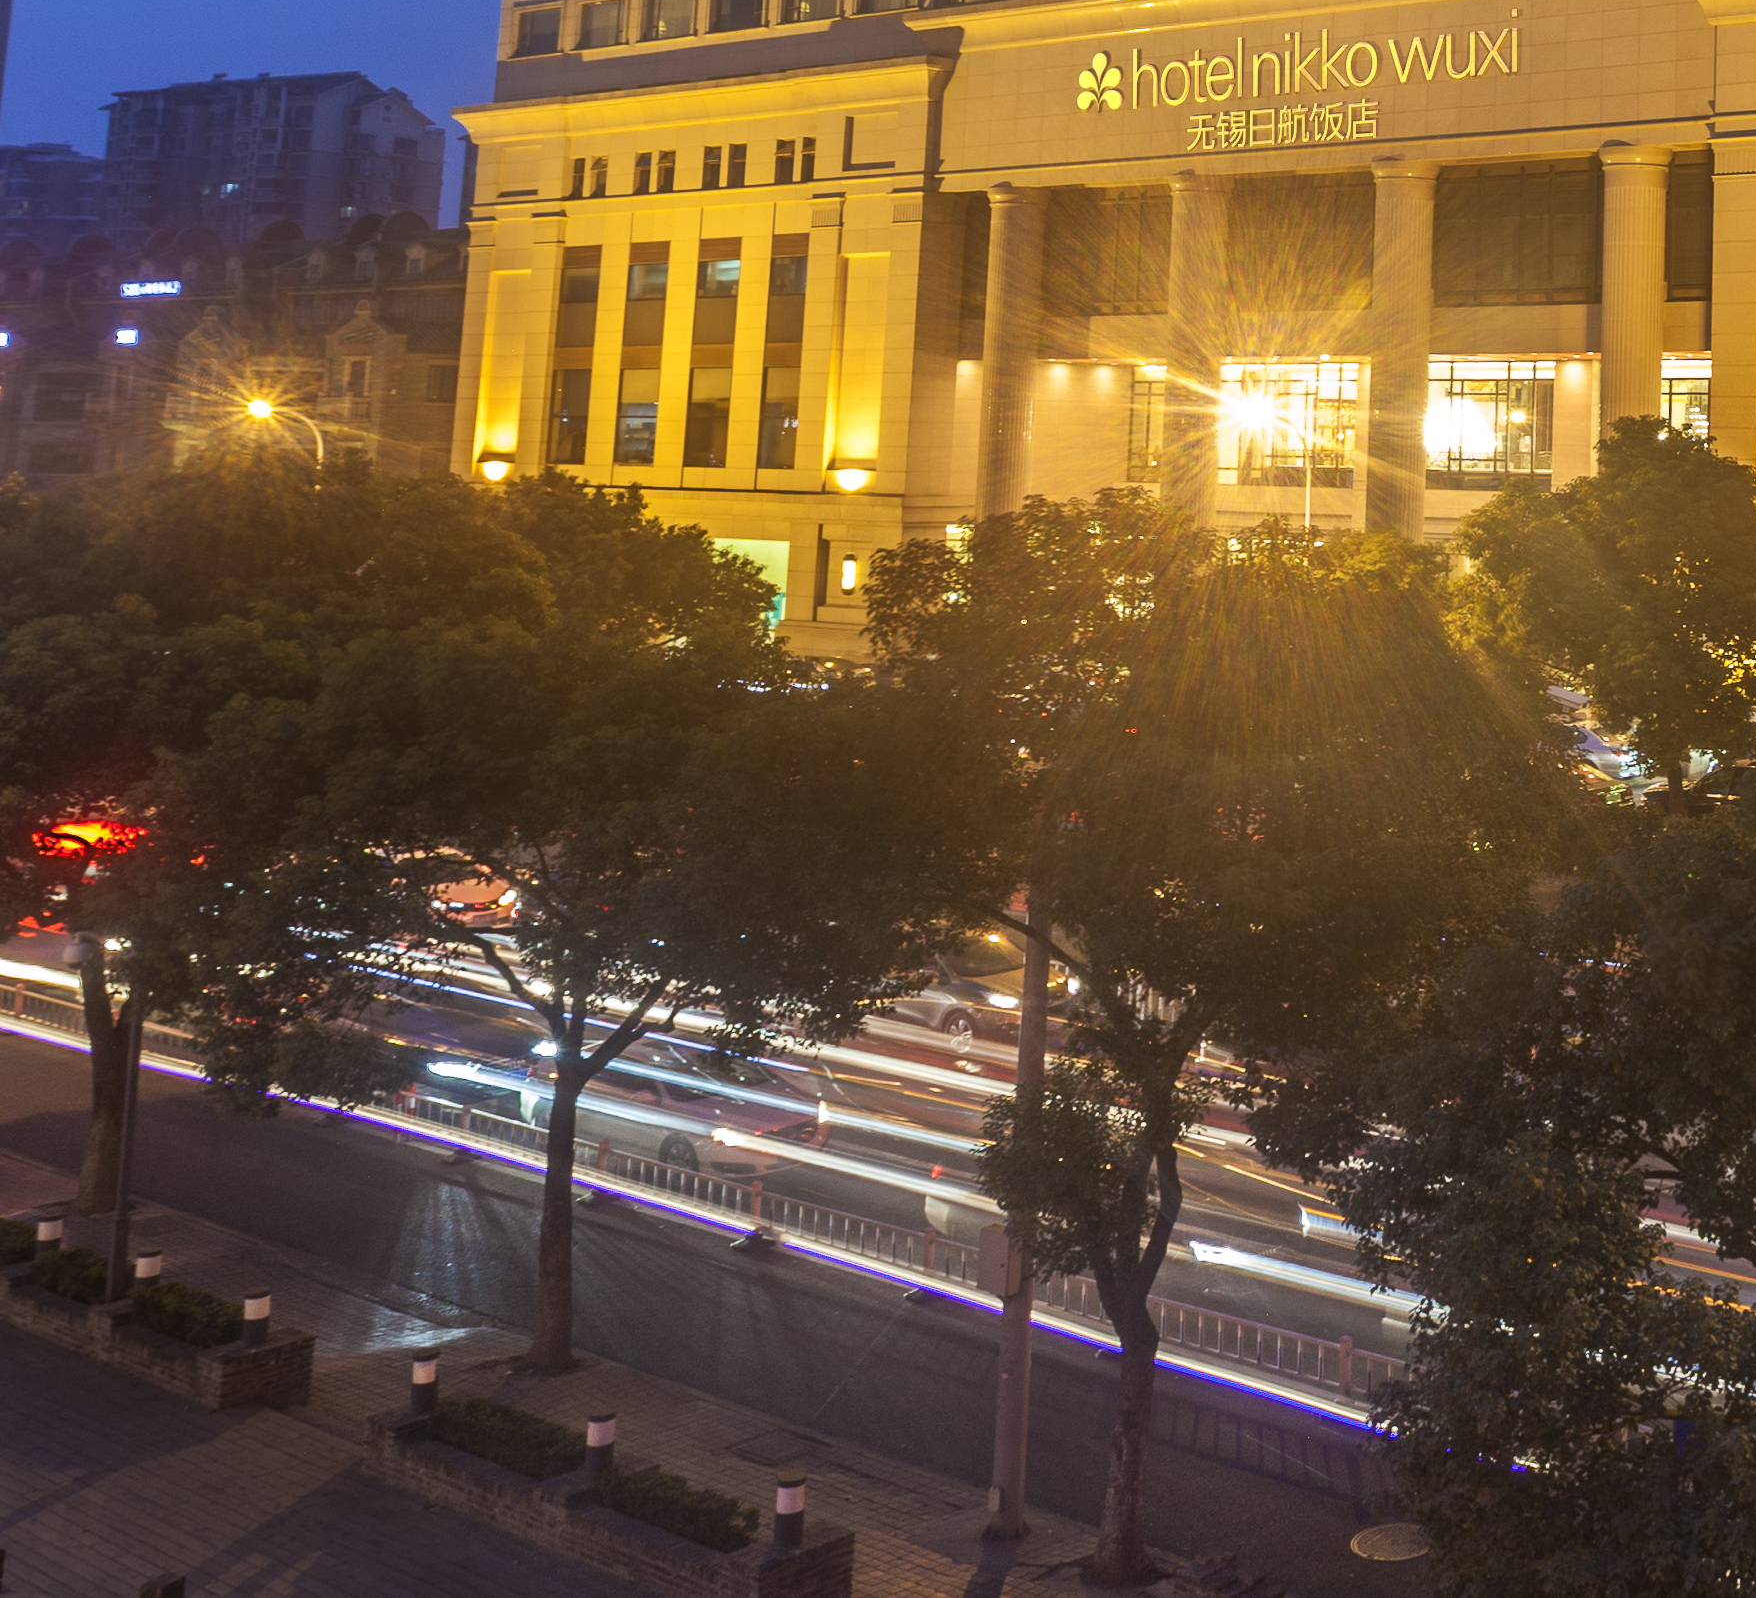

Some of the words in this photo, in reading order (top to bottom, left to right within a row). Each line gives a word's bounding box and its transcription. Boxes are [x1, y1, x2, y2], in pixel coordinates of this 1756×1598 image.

[1131, 37, 1245, 110] hotel
[1251, 28, 1379, 98] nikko
[1387, 8, 1519, 84] wuxi
[1186, 98, 1379, 151] 无锡日航饭店
